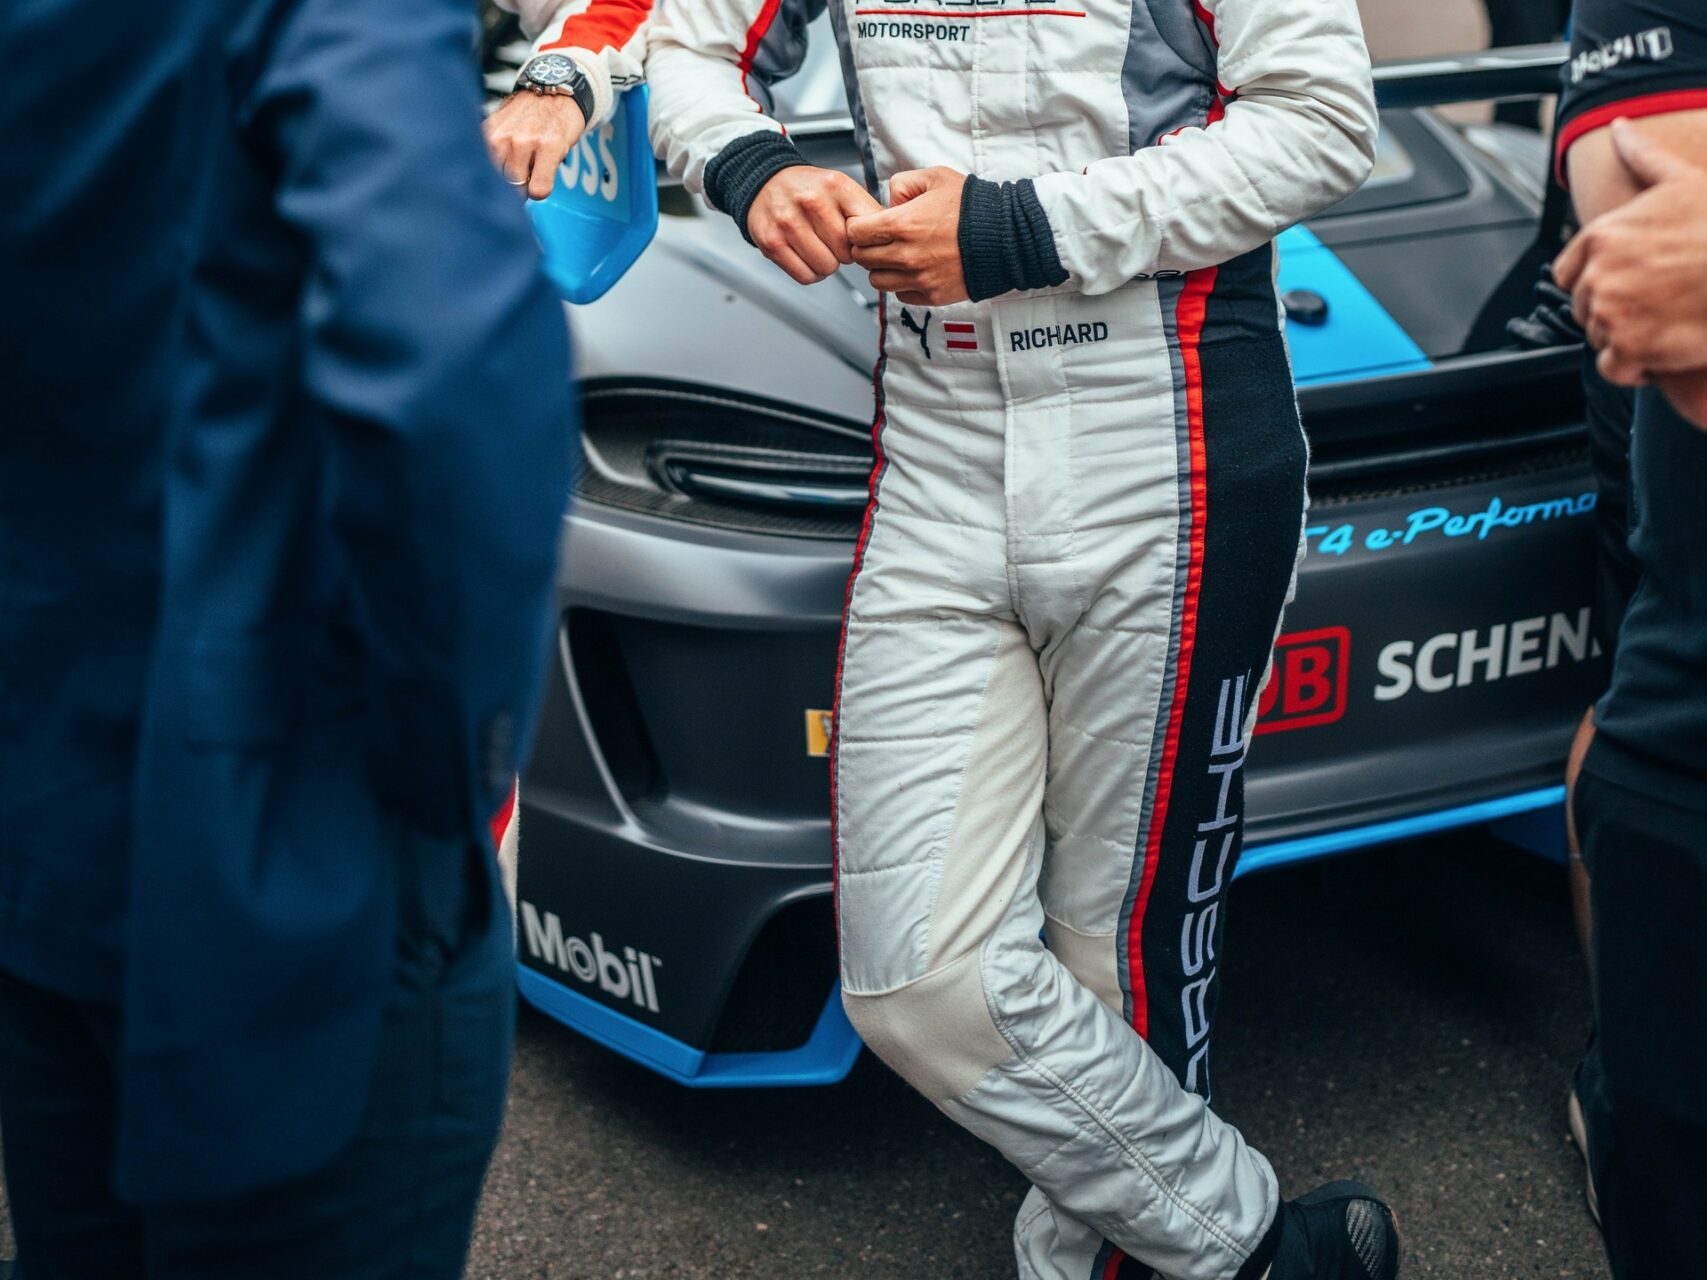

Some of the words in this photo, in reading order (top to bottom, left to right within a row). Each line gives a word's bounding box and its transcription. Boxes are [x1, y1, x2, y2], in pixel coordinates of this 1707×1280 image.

[857, 21, 971, 42] MOTORSPORT
[1009, 321, 1109, 352] RICHARD
[1364, 492, 1598, 551] e-Performa
[1373, 606, 1602, 702] SCHEN
[1181, 669, 1250, 1105] ORSCHE
[520, 899, 661, 1014] Mobil
